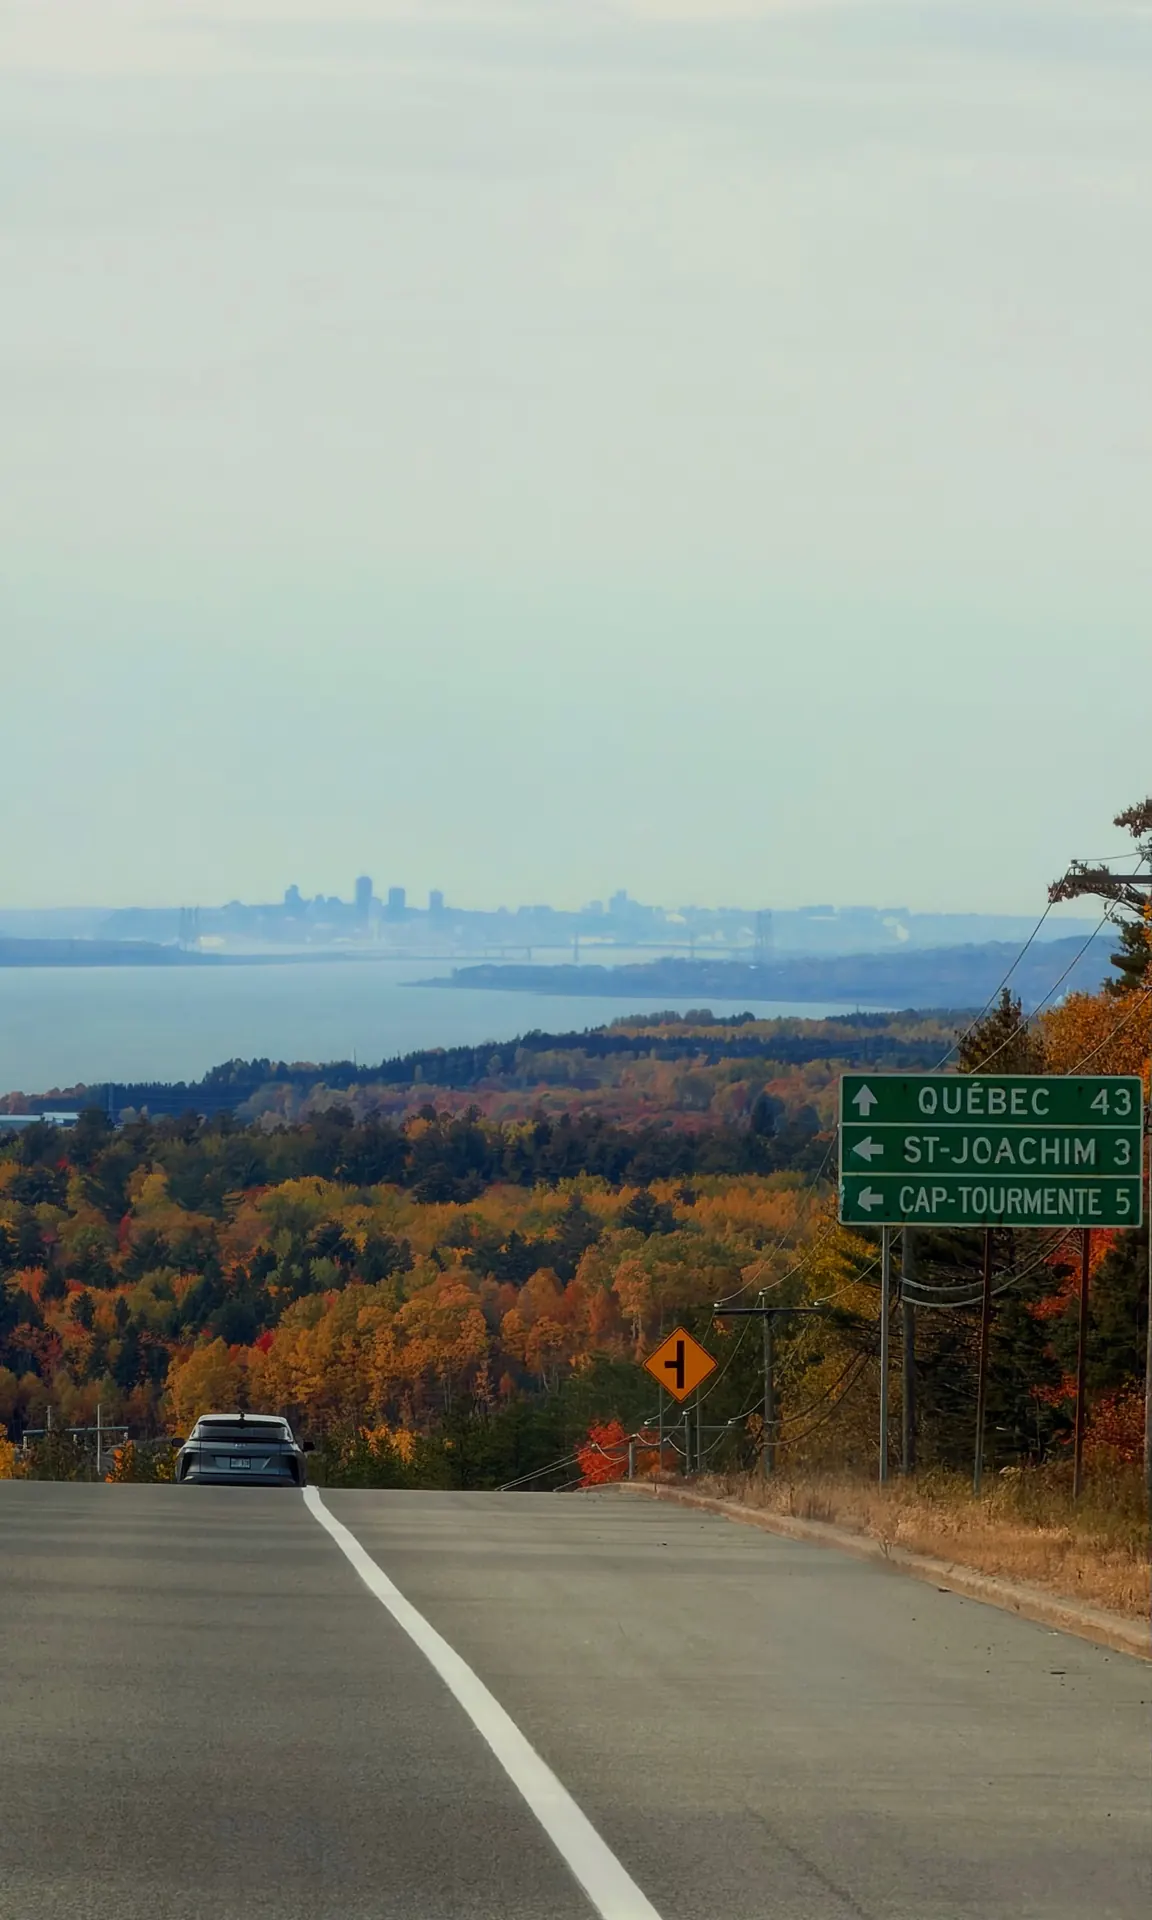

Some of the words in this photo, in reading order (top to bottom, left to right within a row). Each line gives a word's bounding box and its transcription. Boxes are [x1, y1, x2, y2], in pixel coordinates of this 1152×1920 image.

[918, 1082, 1050, 1115] QUÉBEC
[1090, 1089, 1131, 1115] 43
[903, 1136, 1096, 1165] ST-JOACHIM
[1113, 1139, 1130, 1165] 3
[899, 1186, 1102, 1215] CAP-TOURMENTE
[1116, 1189, 1130, 1215] 5
